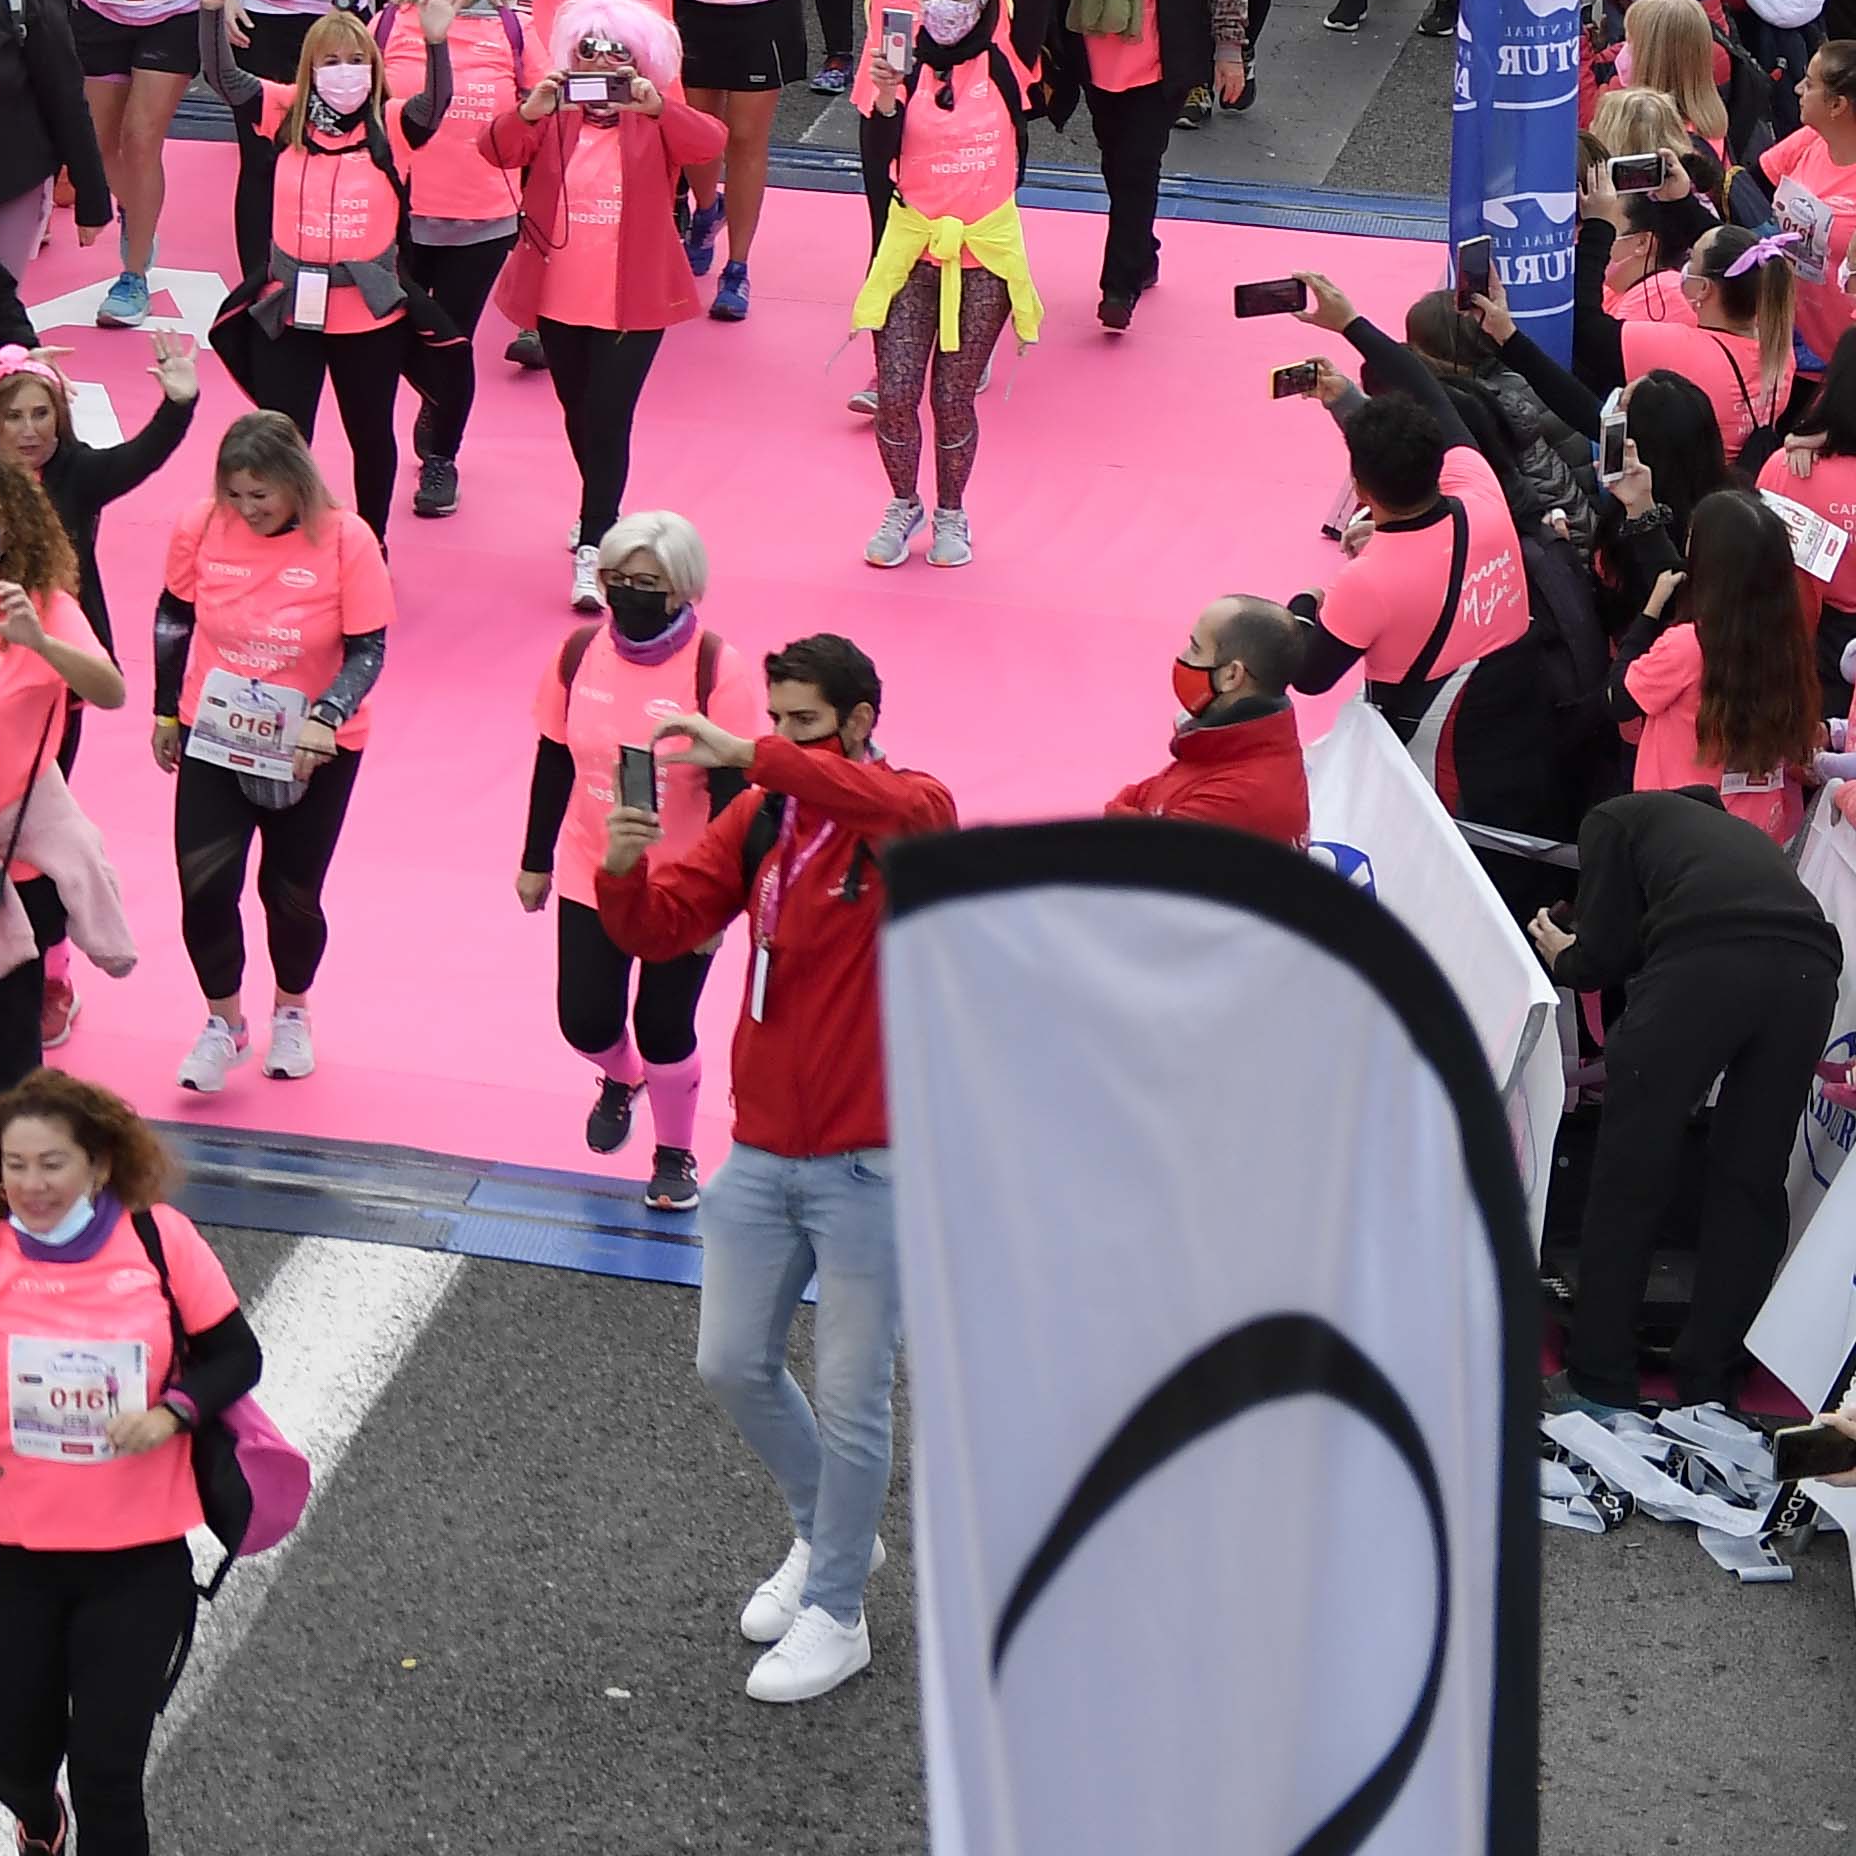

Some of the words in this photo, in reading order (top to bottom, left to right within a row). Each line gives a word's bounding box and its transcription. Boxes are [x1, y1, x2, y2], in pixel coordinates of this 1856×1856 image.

[341, 200, 368, 208] POR
[268, 628, 301, 641] POR
[230, 713, 271, 735] 016
[50, 1389, 104, 1409] 016
